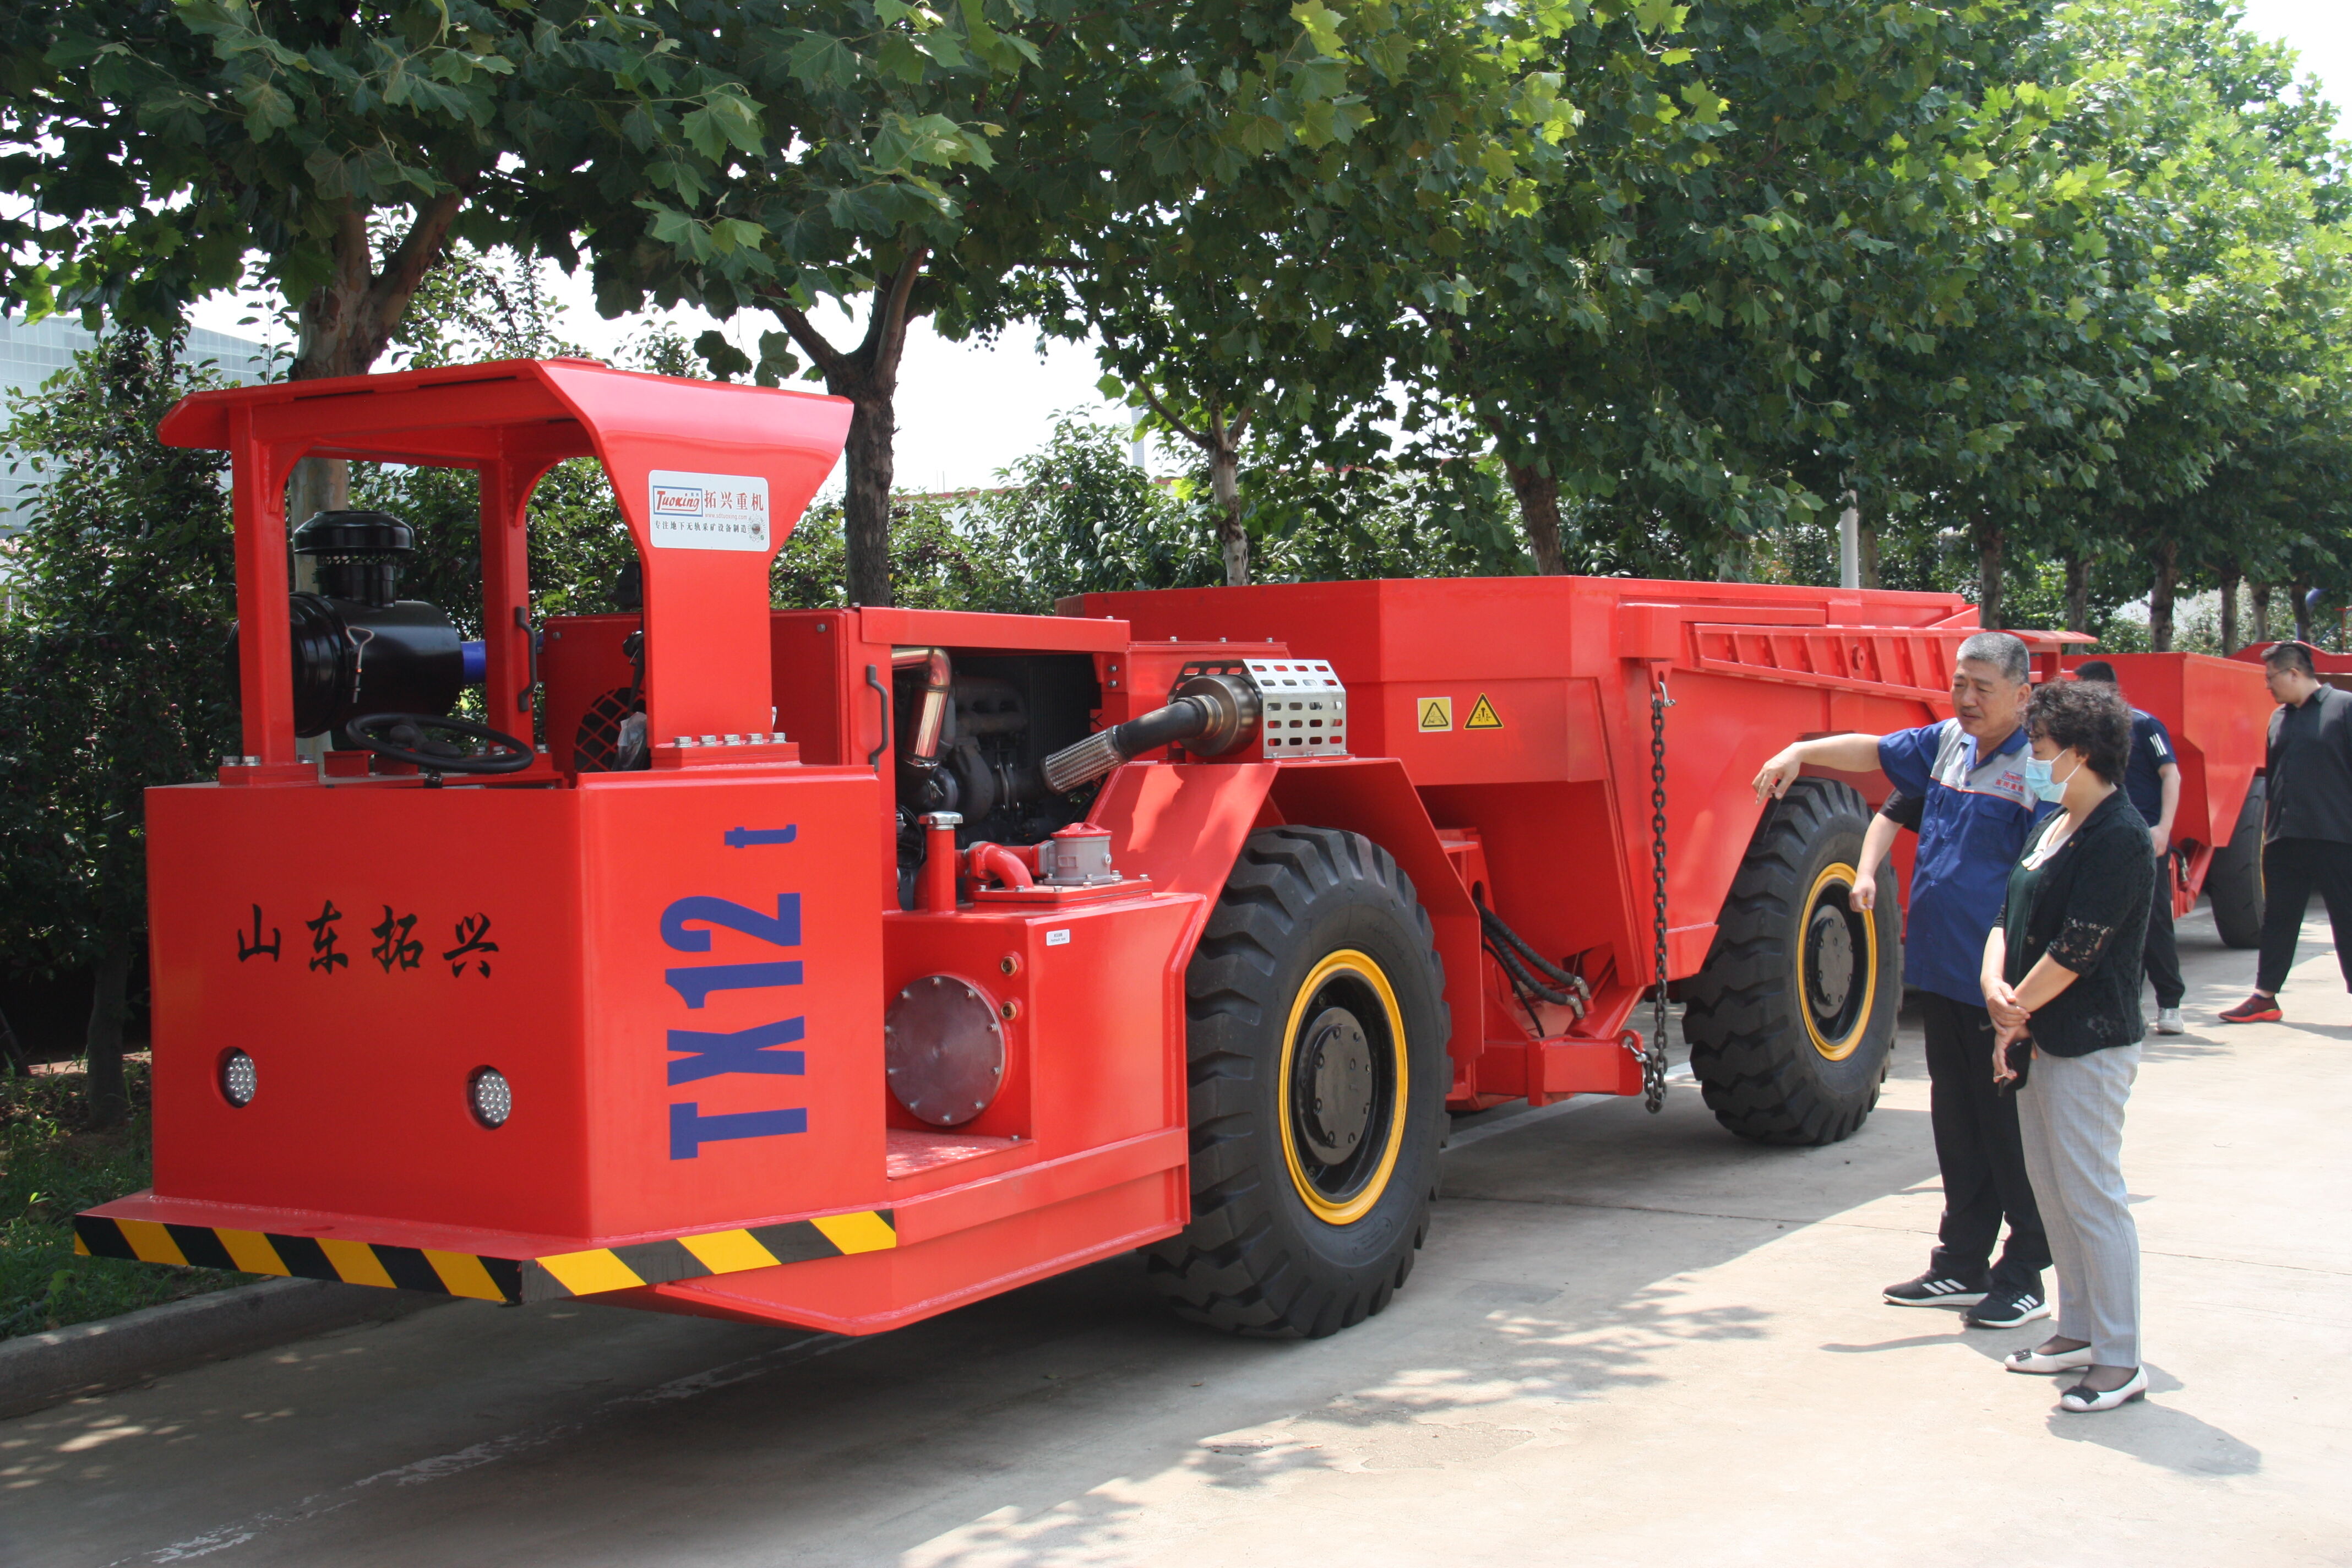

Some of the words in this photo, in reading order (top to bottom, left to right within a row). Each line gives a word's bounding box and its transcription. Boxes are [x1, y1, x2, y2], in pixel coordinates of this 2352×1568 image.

[656, 491, 700, 511] Tuoxing
[704, 489, 764, 511] 拓兴重机
[655, 520, 747, 533] 专注地下无轨采矿设备制造
[724, 824, 797, 848] t
[237, 899, 499, 979] 山东拓兴
[660, 892, 807, 1160] TX12
